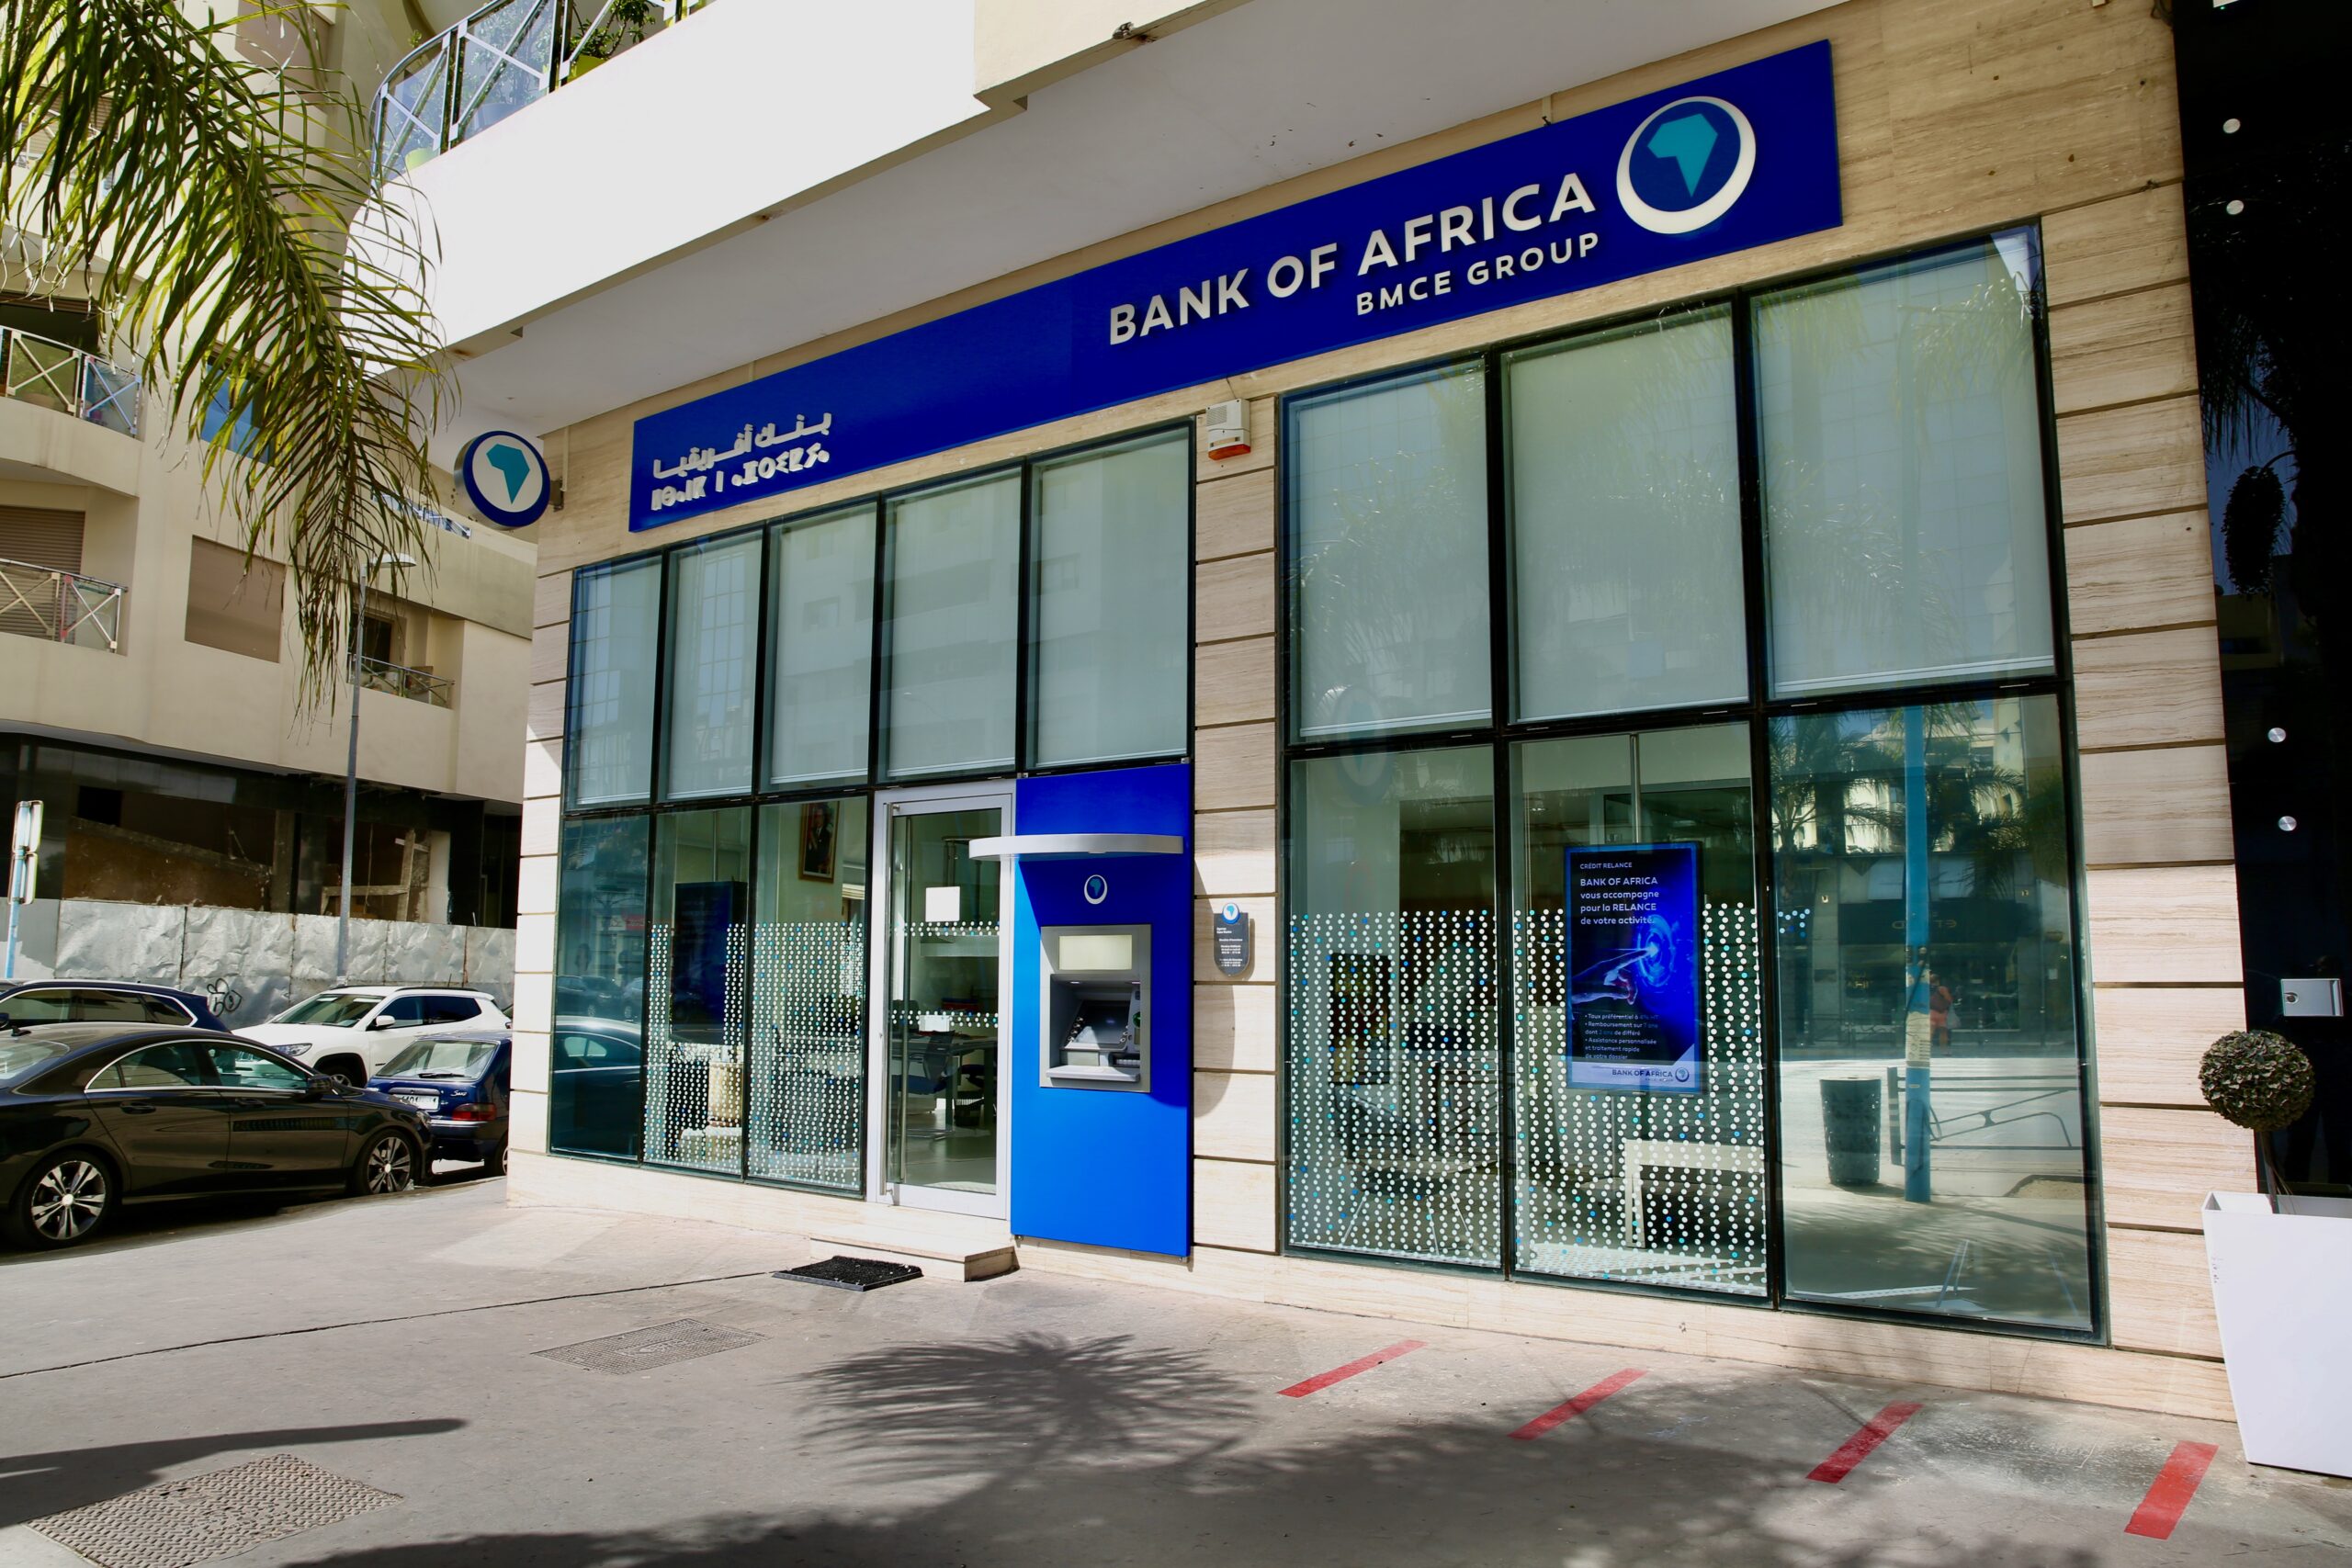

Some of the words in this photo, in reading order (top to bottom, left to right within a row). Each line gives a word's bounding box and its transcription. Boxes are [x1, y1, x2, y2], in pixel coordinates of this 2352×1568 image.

[1109, 268, 1250, 345] BANK
[1266, 243, 1339, 299] OF
[1356, 173, 1596, 276] AFRICA
[1356, 270, 1452, 316] BMCE
[1466, 231, 1599, 287] GROUP
[1580, 878, 1606, 886] BANK
[1608, 877, 1621, 886] OF
[1623, 876, 1658, 886] AFRICA
[1602, 891, 1659, 900] accompagne
[1580, 905, 1600, 914] pour
[1602, 903, 1611, 911] la
[1612, 903, 1657, 911] RELANCE
[1580, 917, 1591, 925] de
[1611, 1068, 1634, 1077] BANK
